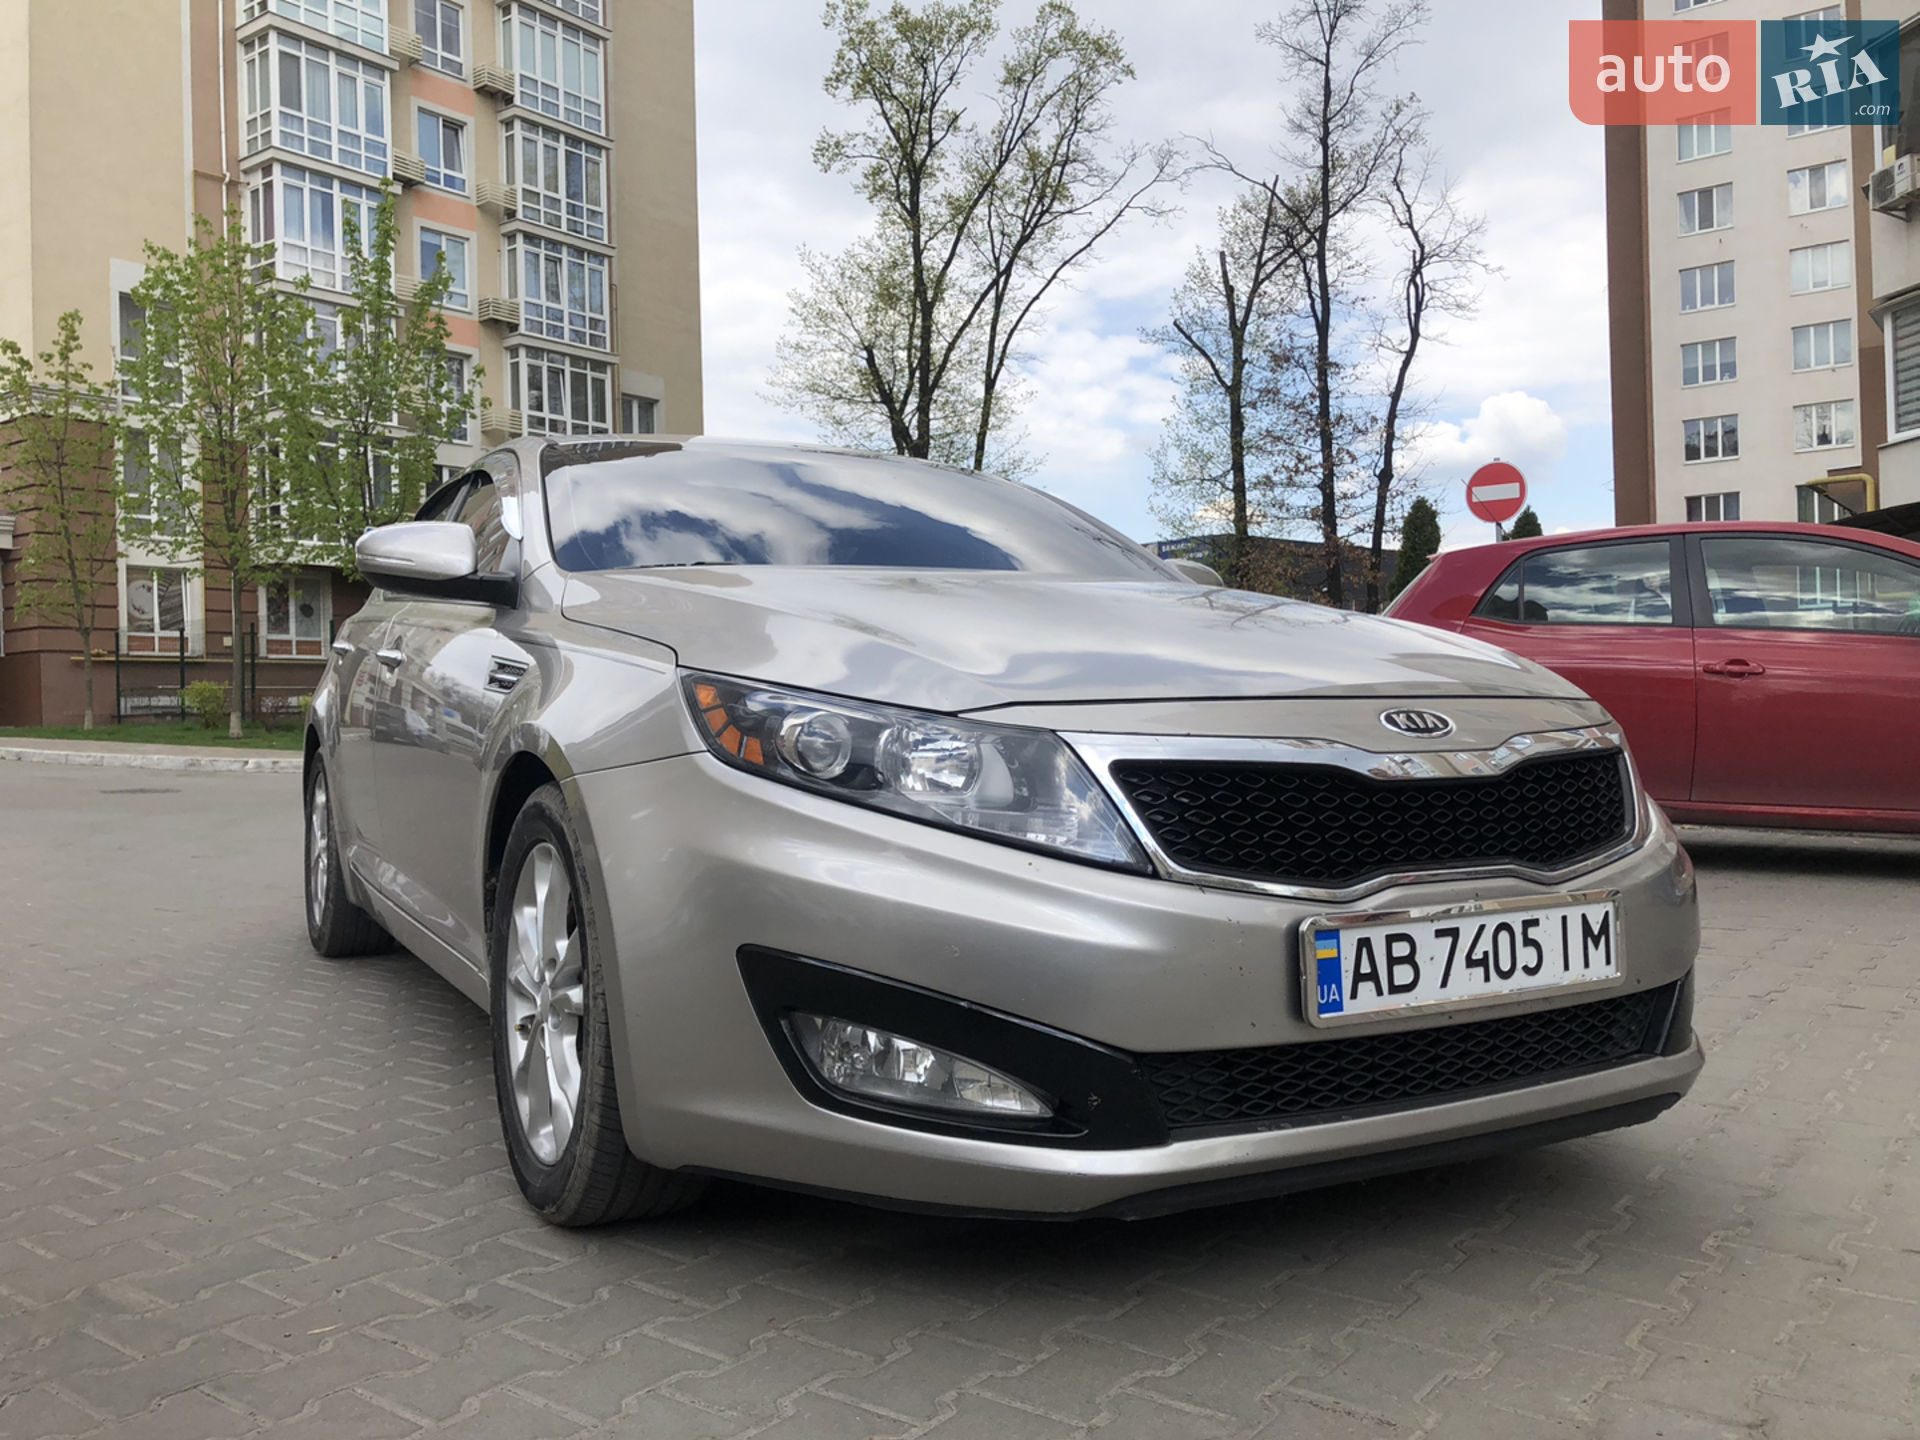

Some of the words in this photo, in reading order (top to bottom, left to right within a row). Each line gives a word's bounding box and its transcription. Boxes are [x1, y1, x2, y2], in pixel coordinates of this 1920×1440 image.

[1390, 712, 1445, 729] KIA
[1350, 932, 1421, 1000] AB
[1434, 917, 1544, 988] 7405
[1561, 910, 1611, 972] IM
[1317, 983, 1340, 1004] UA
